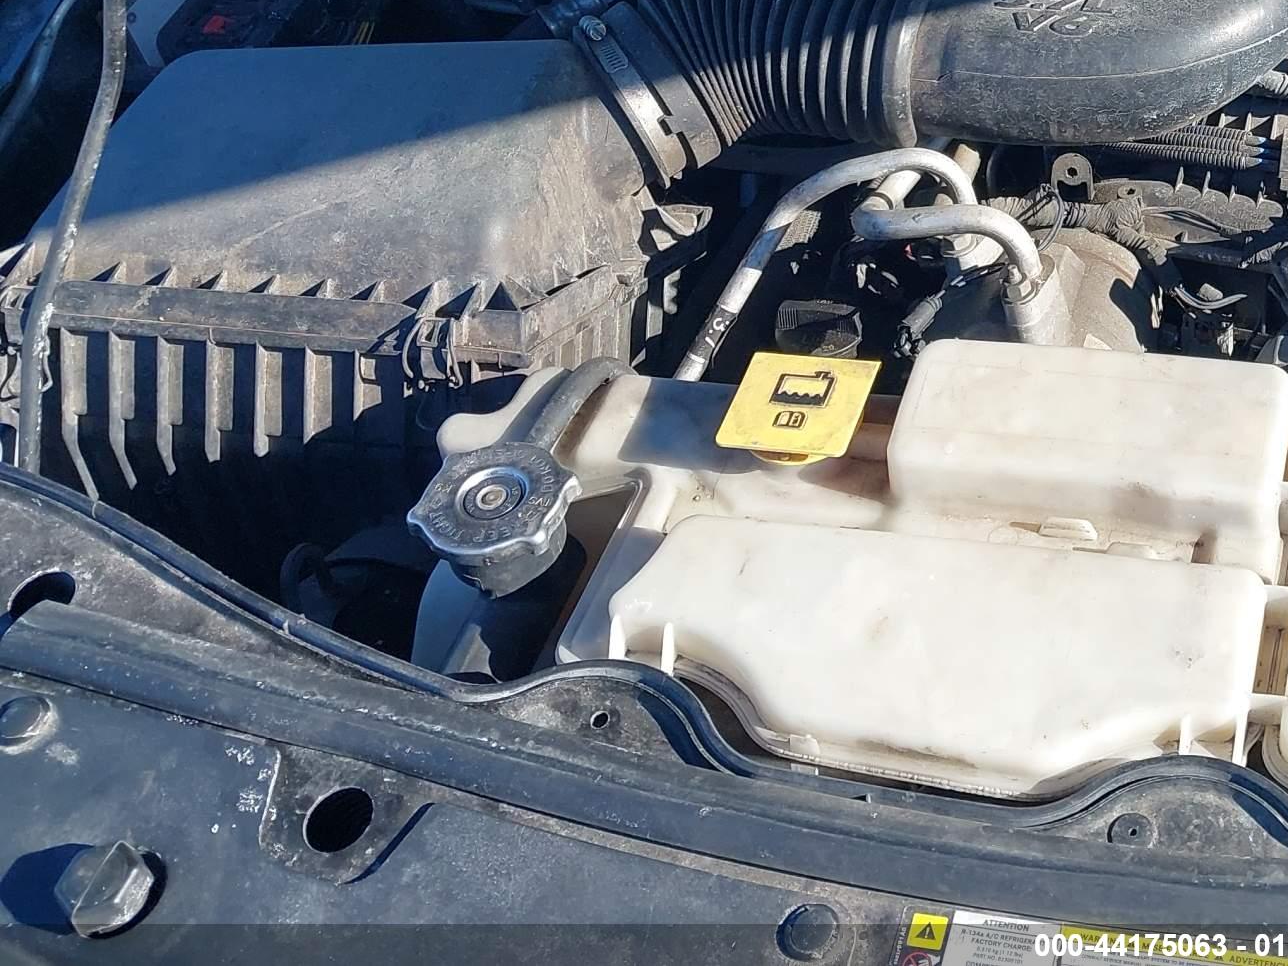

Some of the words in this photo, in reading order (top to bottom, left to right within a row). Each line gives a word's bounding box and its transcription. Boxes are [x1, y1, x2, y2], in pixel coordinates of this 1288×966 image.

[1012, 12, 1102, 37] V6
[984, 918, 1030, 932] ATTENTION
[985, 932, 999, 940] A/C
[970, 938, 1002, 949] FACTORY
